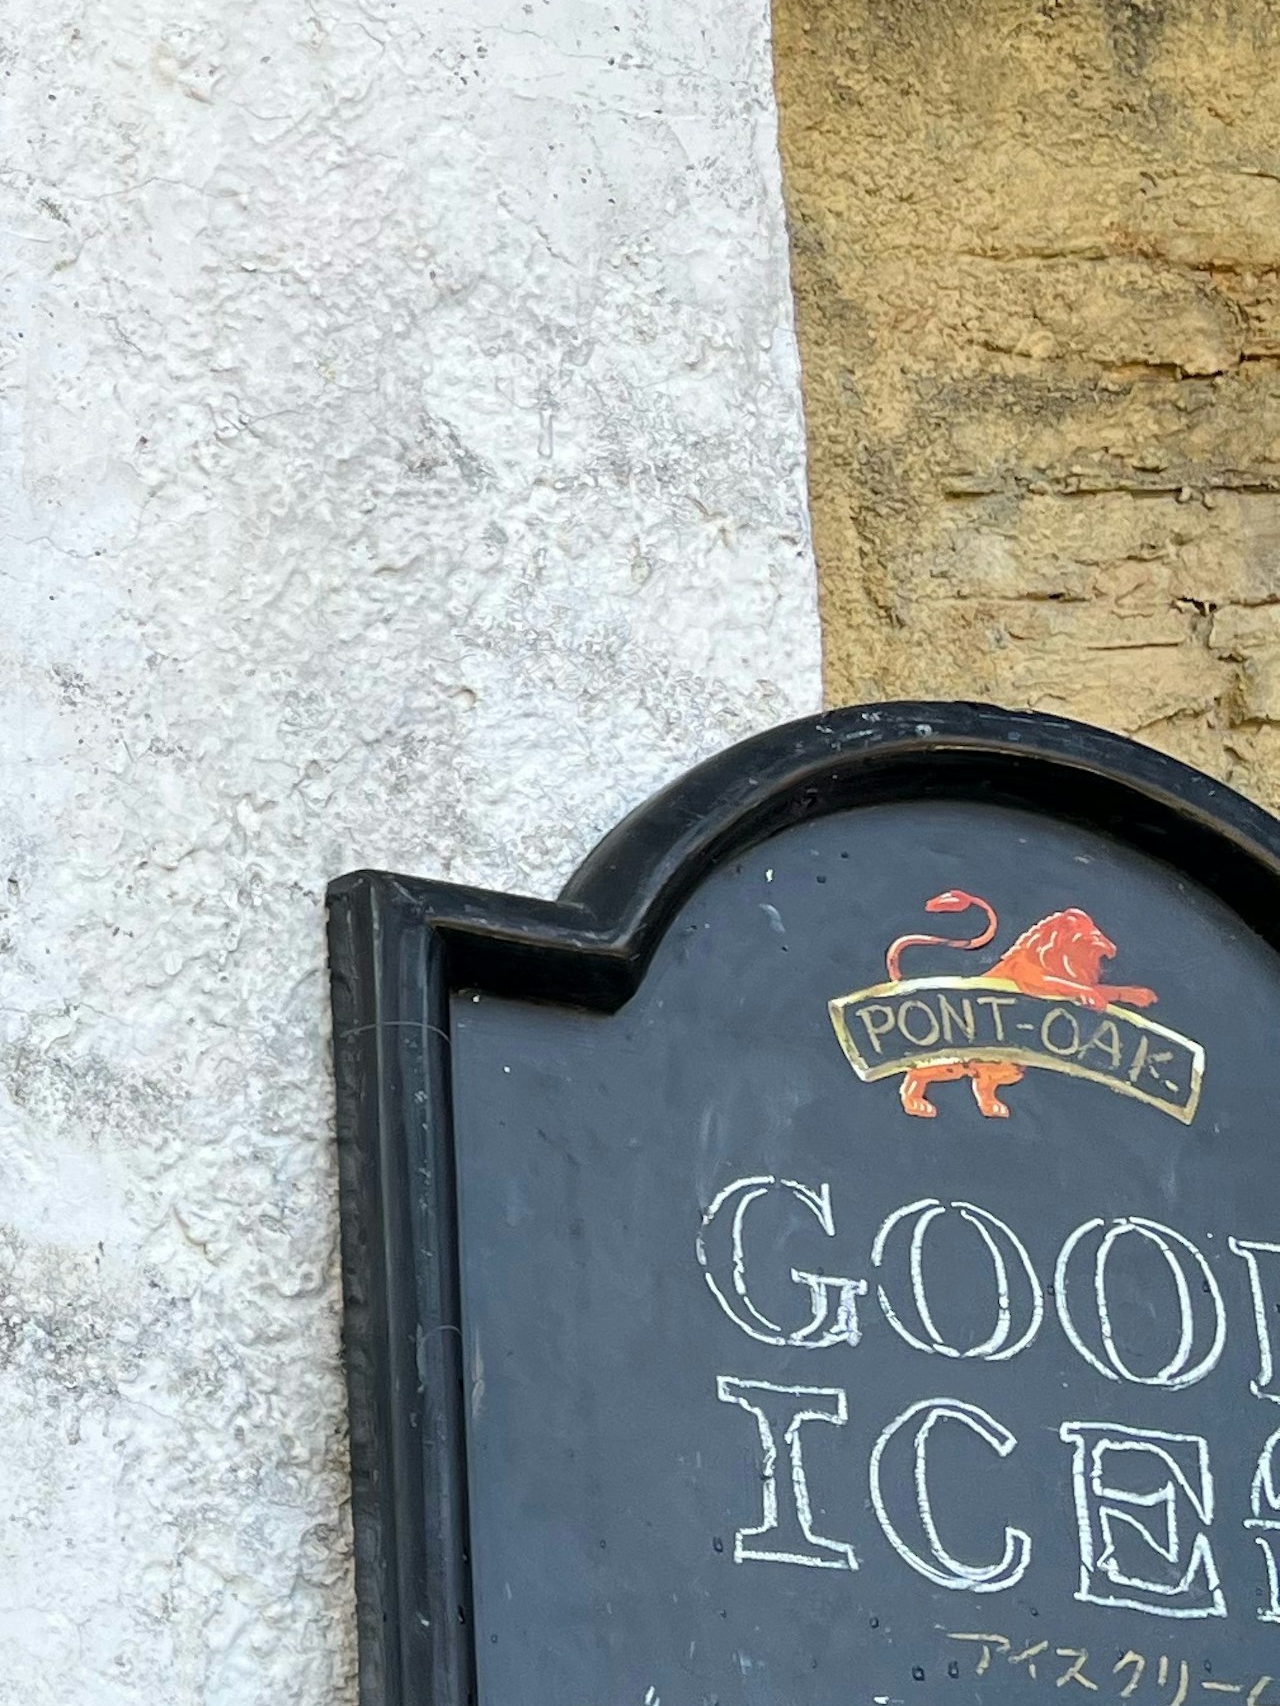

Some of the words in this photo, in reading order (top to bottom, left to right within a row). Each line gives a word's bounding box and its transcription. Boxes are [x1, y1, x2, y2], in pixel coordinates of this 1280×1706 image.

[855, 993, 1181, 1093] PONT-OAK
[696, 1175, 1280, 1399] GOO
[716, 1373, 1280, 1624] ICE
